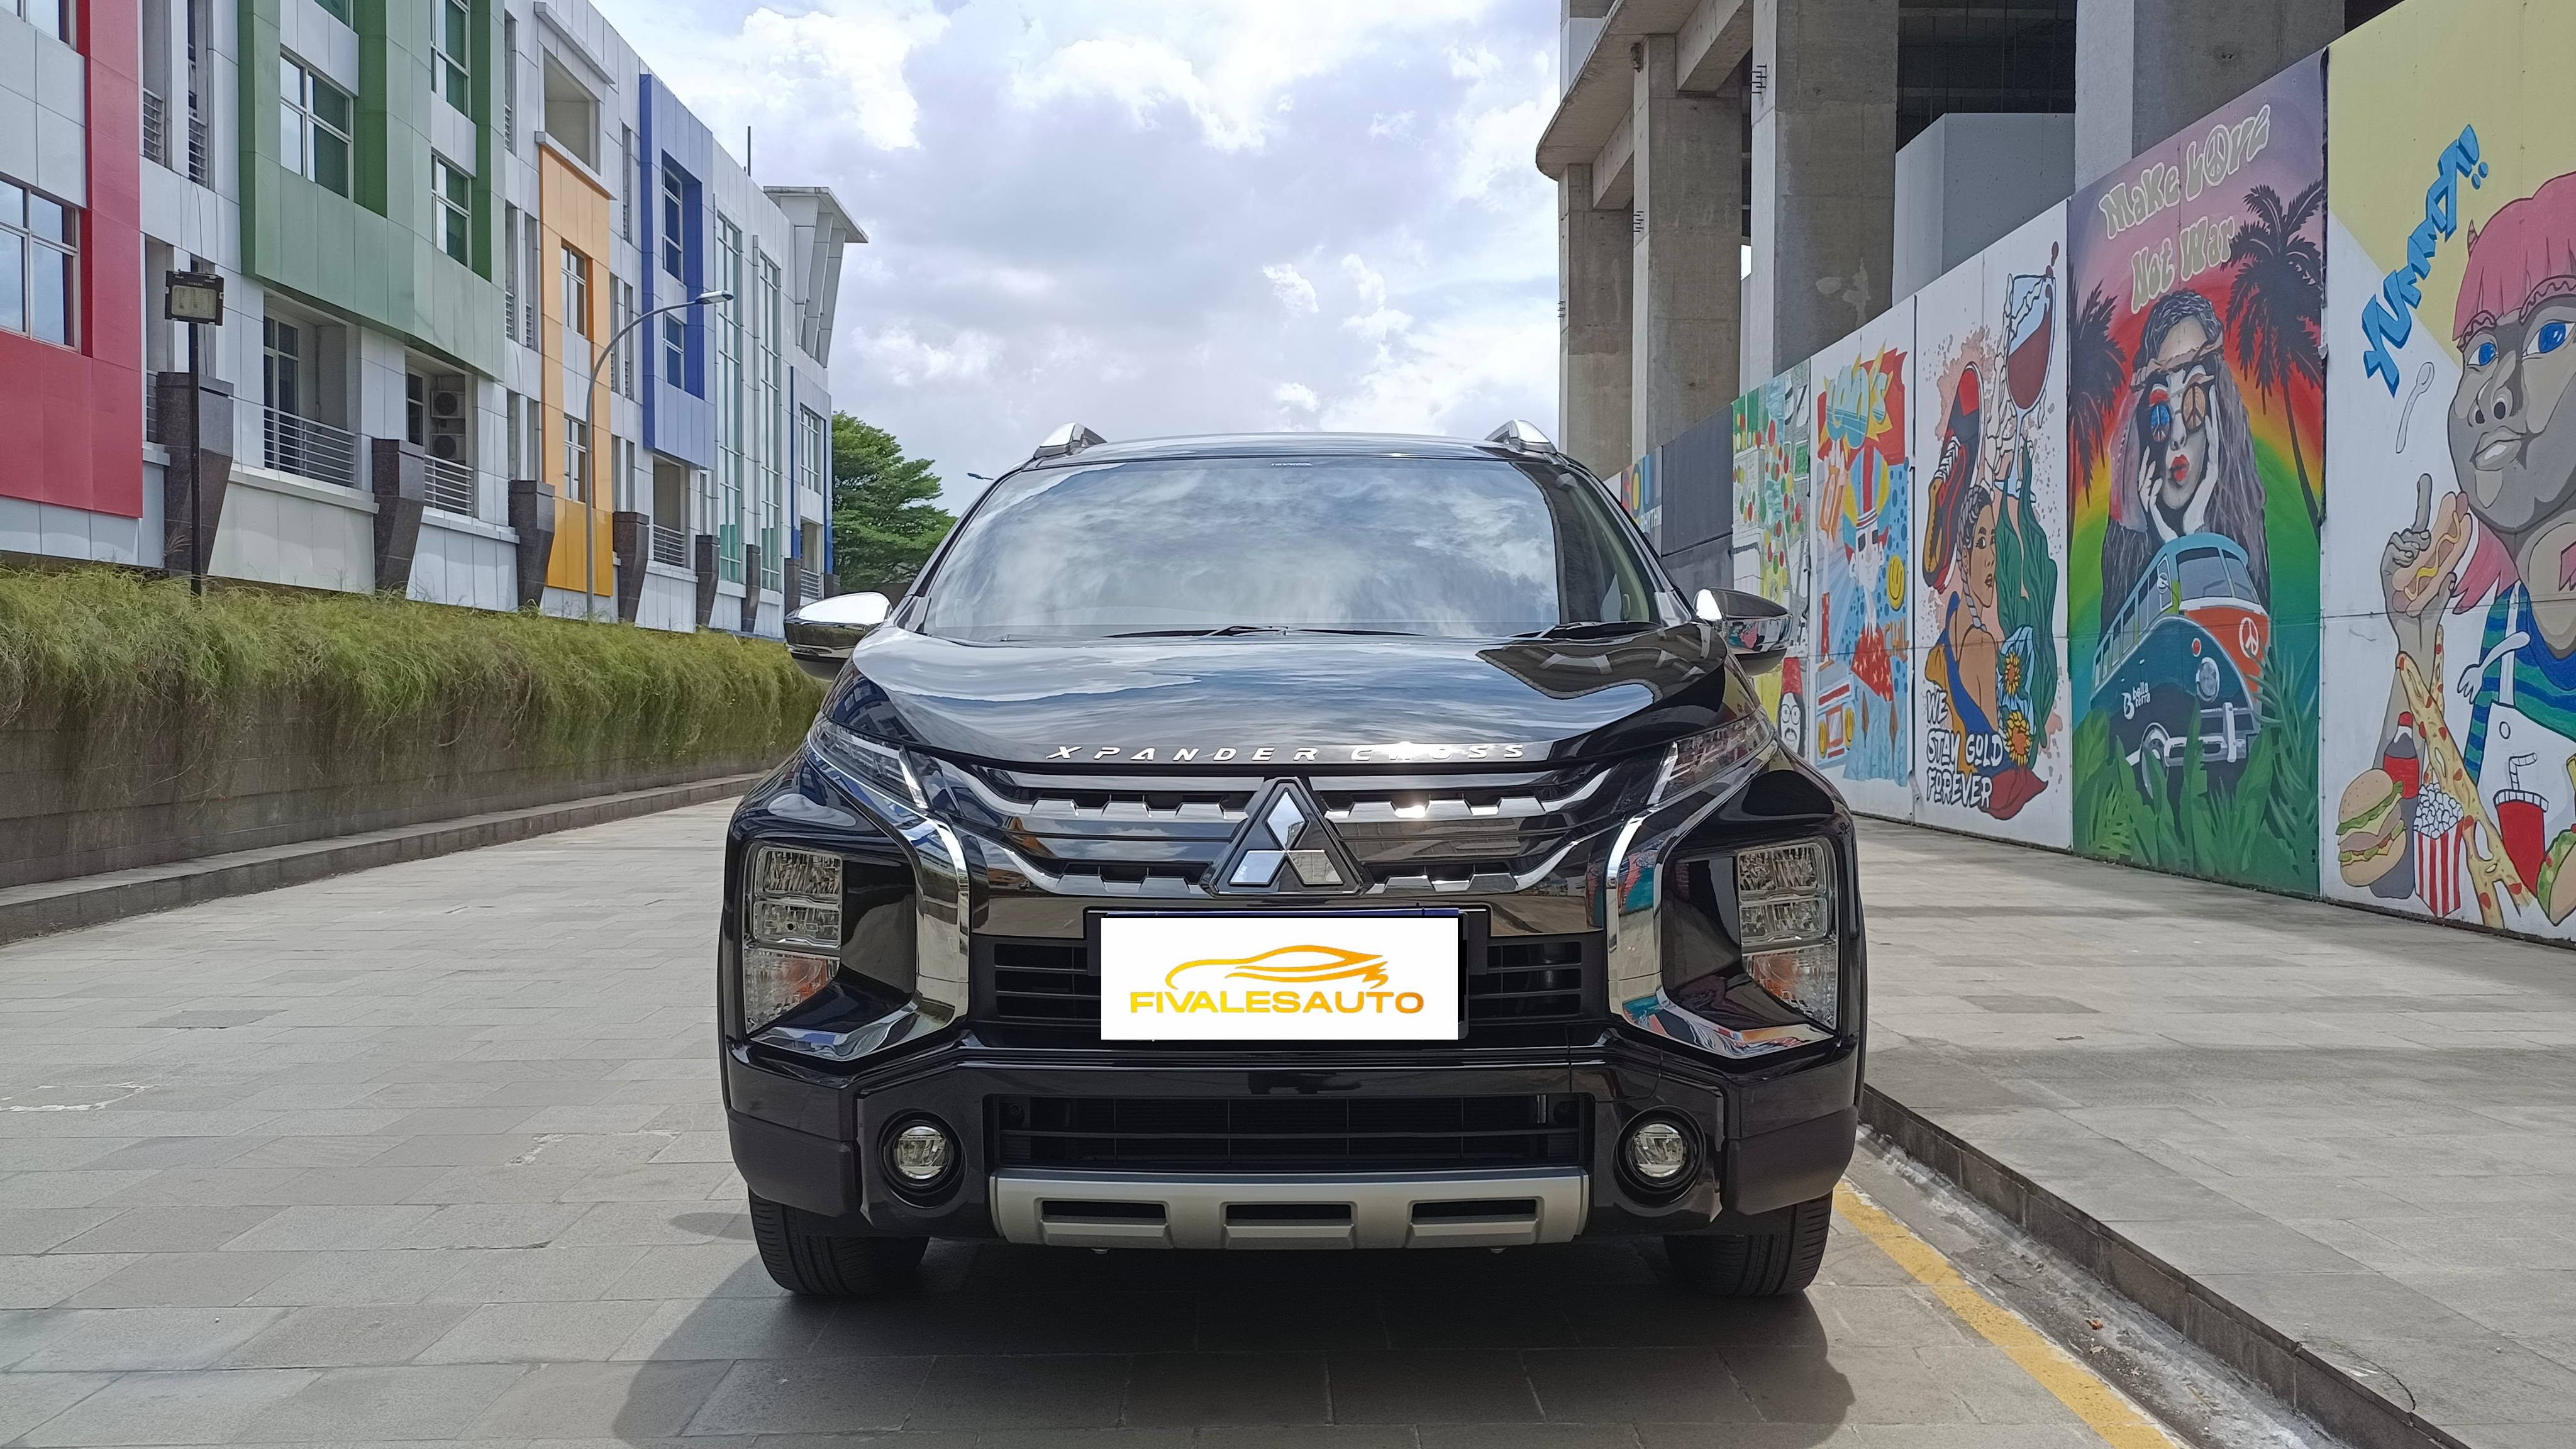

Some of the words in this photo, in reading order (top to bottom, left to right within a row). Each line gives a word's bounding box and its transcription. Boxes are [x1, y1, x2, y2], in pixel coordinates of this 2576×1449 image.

[2131, 238, 2175, 314] Not
[2180, 216, 2235, 282] War
[1926, 689, 1948, 724] WE
[2133, 682, 2149, 701] bella
[2135, 692, 2151, 708] terra
[1046, 746, 1319, 762] XPANDER
[1926, 728, 1961, 774] STAY
[1965, 733, 2003, 767] GOLD
[1926, 767, 1992, 809] FOREVER
